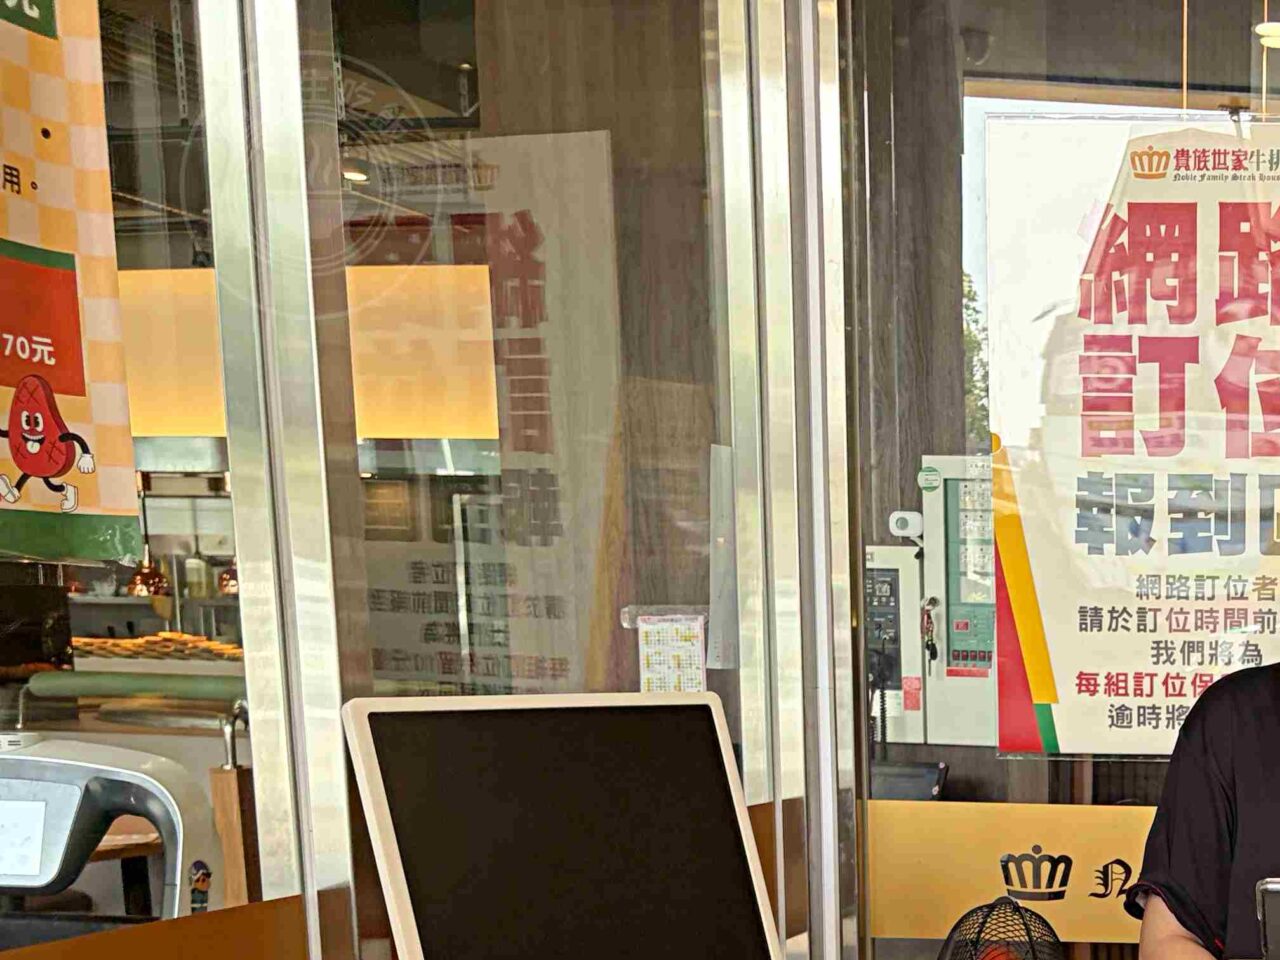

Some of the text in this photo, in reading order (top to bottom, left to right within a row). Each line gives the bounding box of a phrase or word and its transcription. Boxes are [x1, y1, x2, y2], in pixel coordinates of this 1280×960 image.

[1173, 173, 1197, 182] Noble
[1199, 173, 1229, 182] Family
[1231, 173, 1256, 181] Steak
[1135, 574, 1279, 602] 網路訂位者
[1151, 640, 1263, 666] 我們將為
[1075, 671, 1229, 698] 每組訂位保
